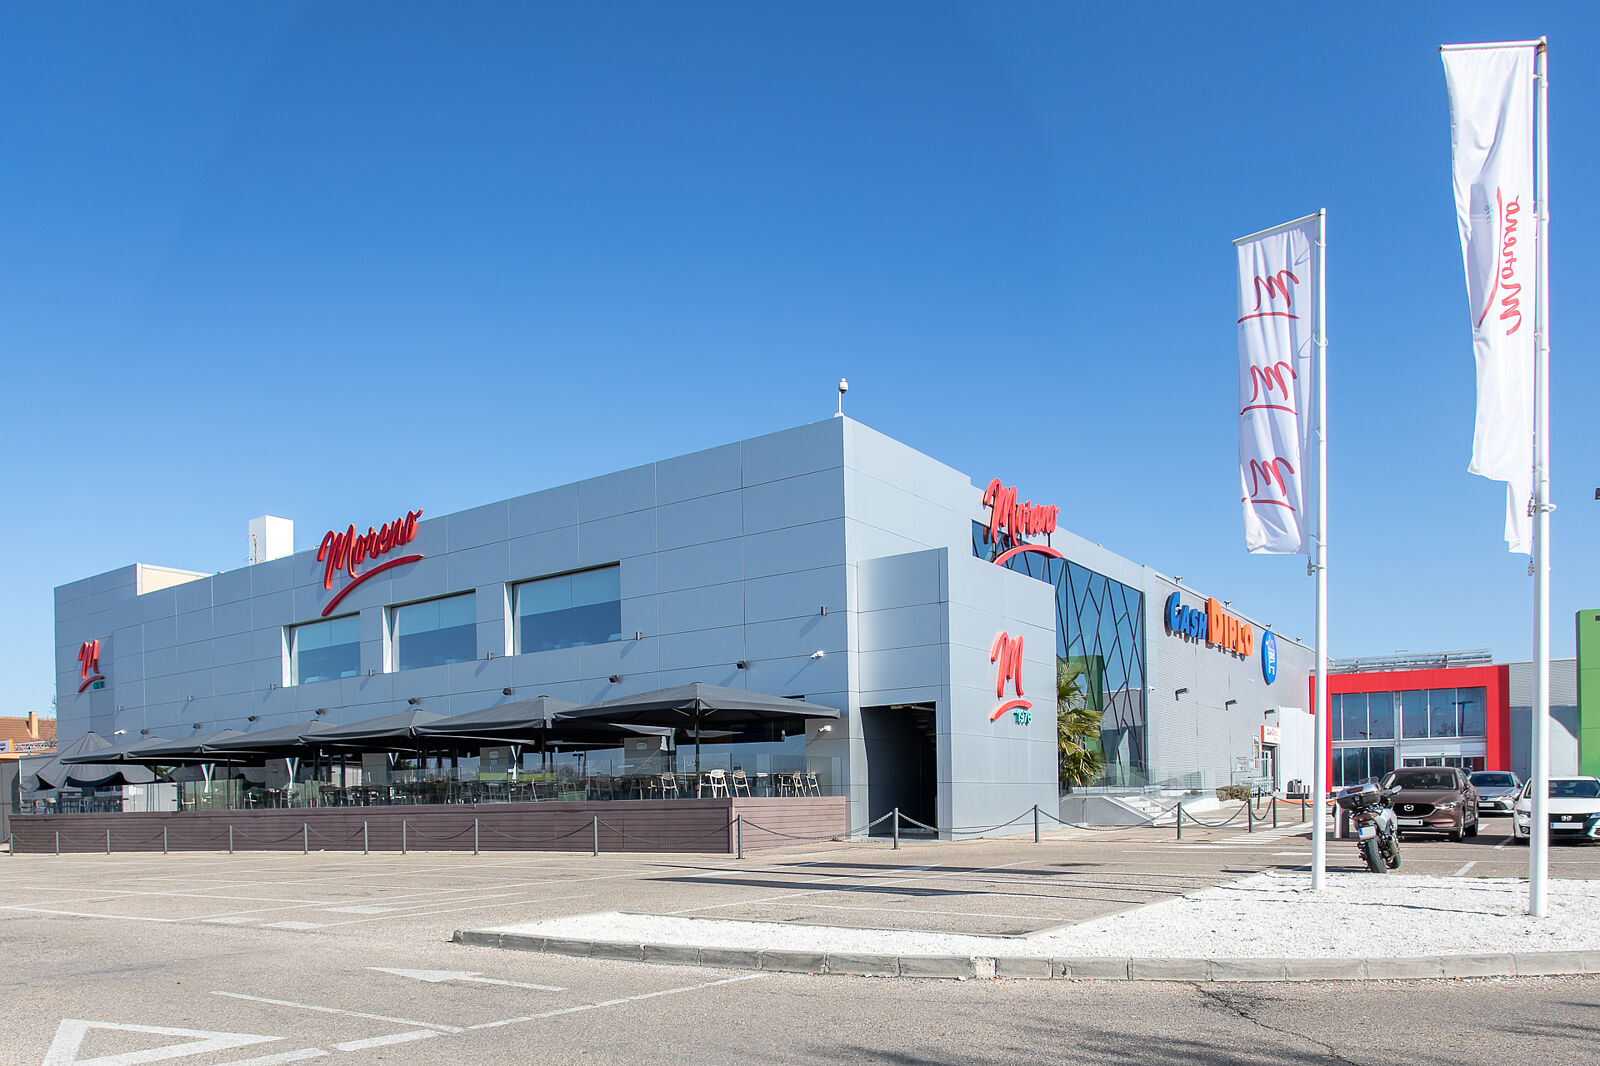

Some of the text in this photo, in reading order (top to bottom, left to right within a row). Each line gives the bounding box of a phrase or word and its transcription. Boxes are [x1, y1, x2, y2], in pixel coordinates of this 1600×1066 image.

[983, 478, 1060, 547] Moreno
[317, 508, 424, 591] Moreno
[78, 639, 101, 680] M
[990, 631, 1025, 699] M
